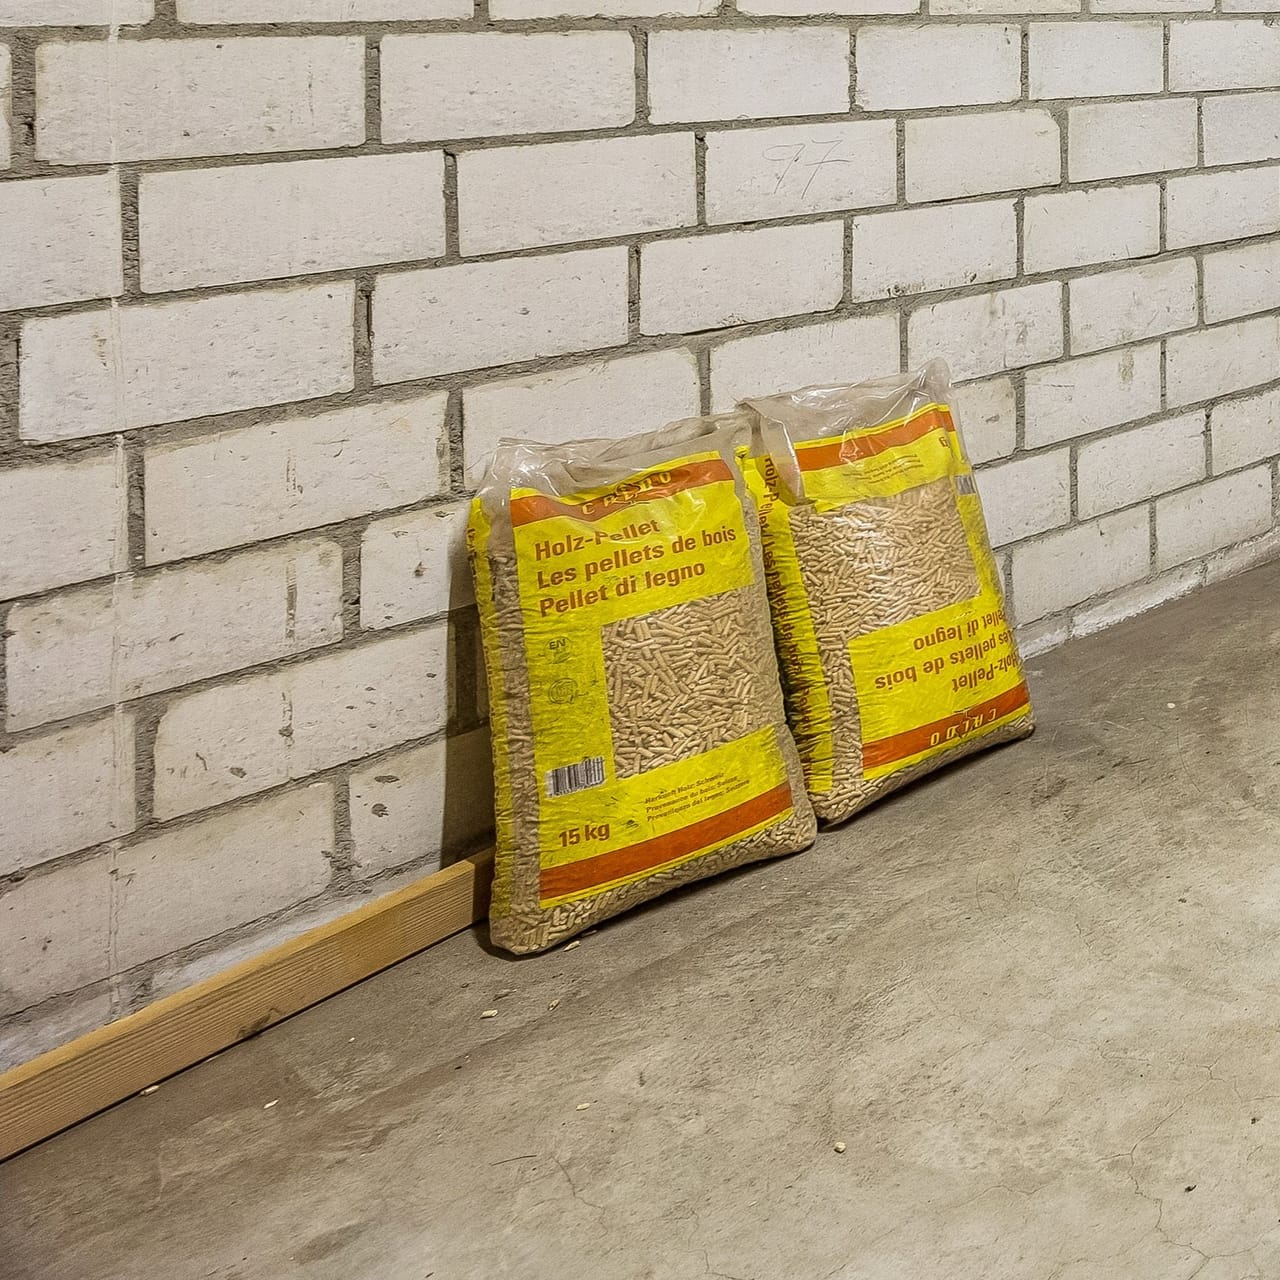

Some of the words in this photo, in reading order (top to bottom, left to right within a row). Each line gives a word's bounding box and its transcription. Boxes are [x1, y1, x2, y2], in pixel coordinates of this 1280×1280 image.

[762, 139, 851, 200] 97
[535, 520, 661, 561] Holz-Pellet
[537, 567, 577, 589] Les
[585, 544, 665, 581] pellets
[671, 534, 697, 554] de
[702, 526, 737, 547] bois
[539, 585, 609, 617] Pellet
[615, 575, 638, 597] di
[645, 562, 706, 589] legno
[913, 627, 963, 651] legno
[967, 620, 980, 637] di
[549, 638, 566, 650] EN
[950, 637, 996, 665] pellets
[875, 666, 918, 690] bois
[922, 657, 945, 675] de
[951, 653, 1019, 693] Holz-Pellet
[559, 827, 581, 848] 15
[584, 823, 611, 842] kg
